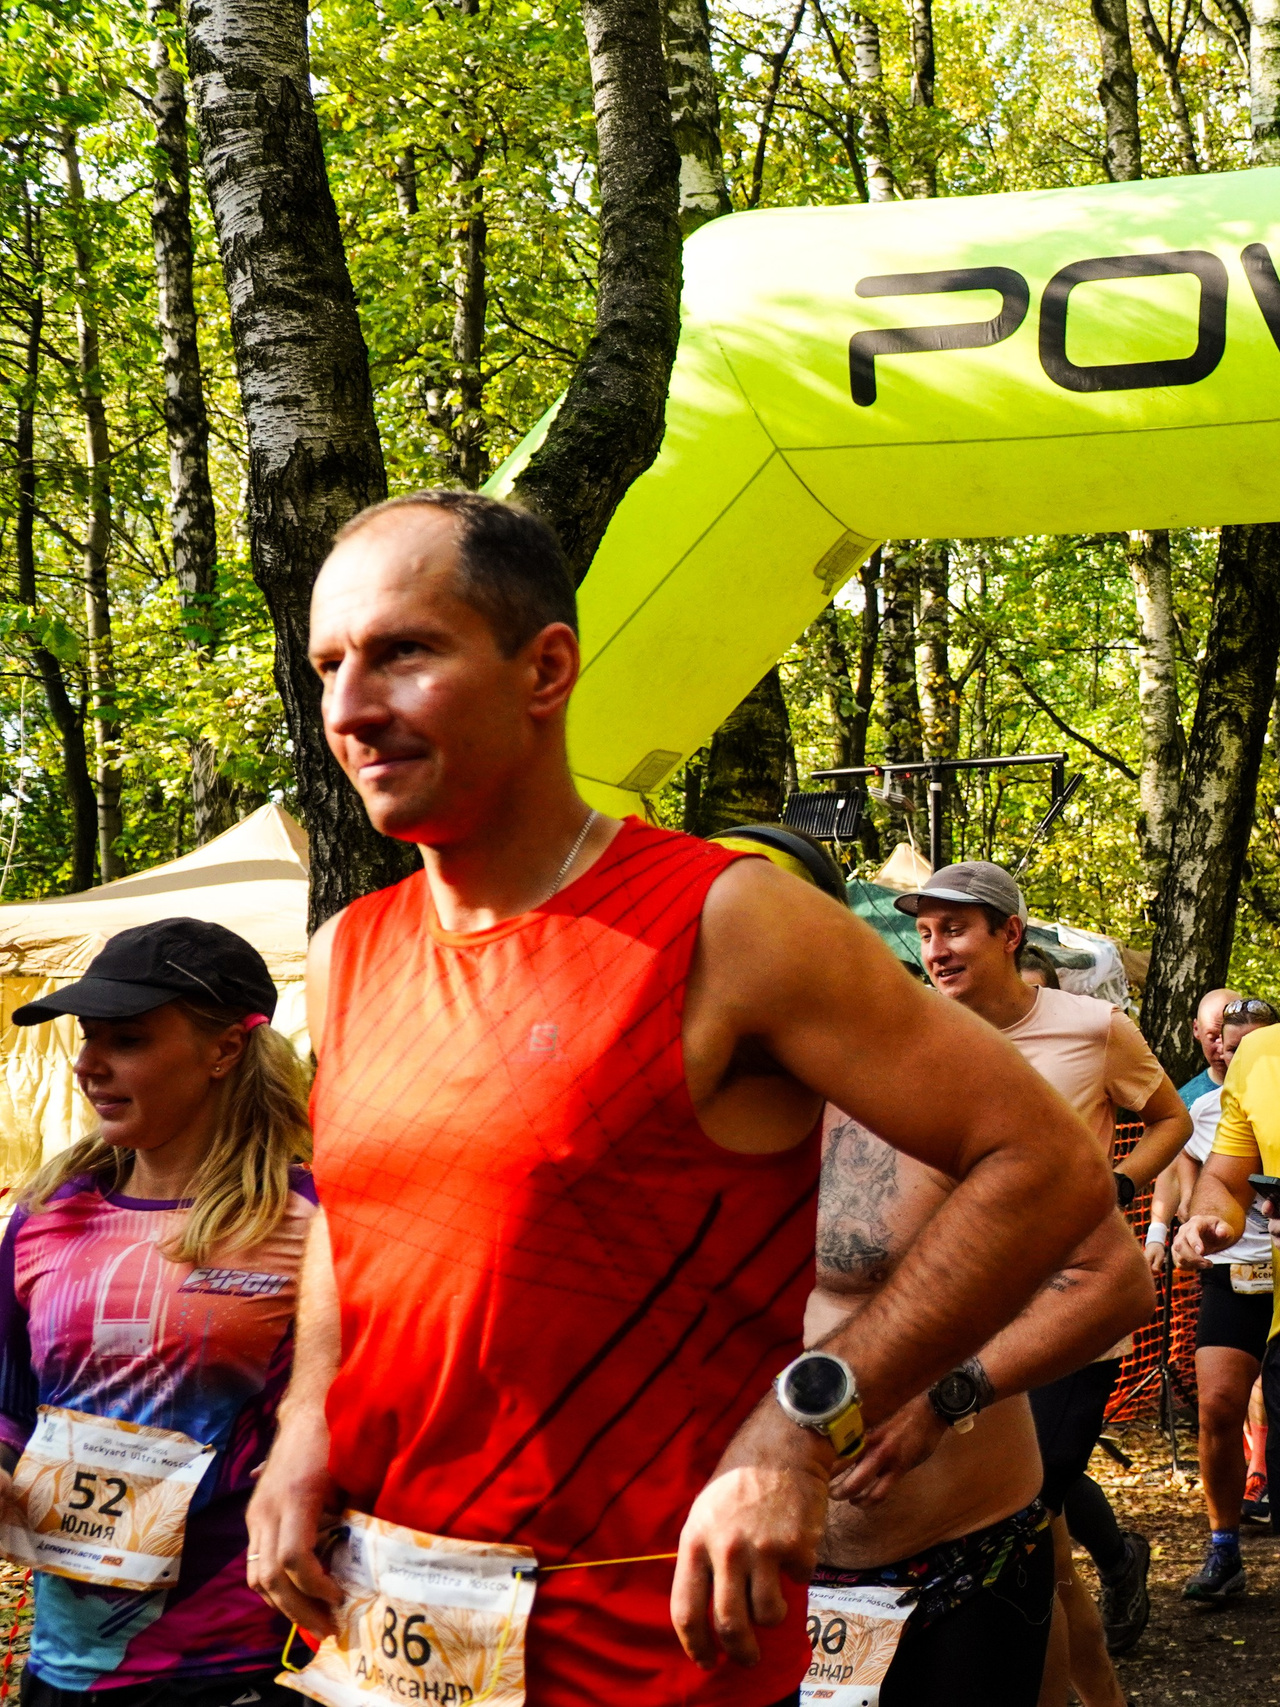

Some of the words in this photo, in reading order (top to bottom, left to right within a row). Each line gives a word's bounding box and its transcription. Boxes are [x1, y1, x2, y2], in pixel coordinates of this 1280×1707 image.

[83, 1443, 126, 1457] Backyard
[131, 1452, 157, 1464] Ultra
[68, 1471, 128, 1517] 52
[60, 1513, 116, 1541] Юлия
[469, 1579, 510, 1591] Moscow
[867, 1599, 897, 1610] Moscow
[381, 1606, 432, 1667] 86
[355, 1655, 474, 1707] Александр
